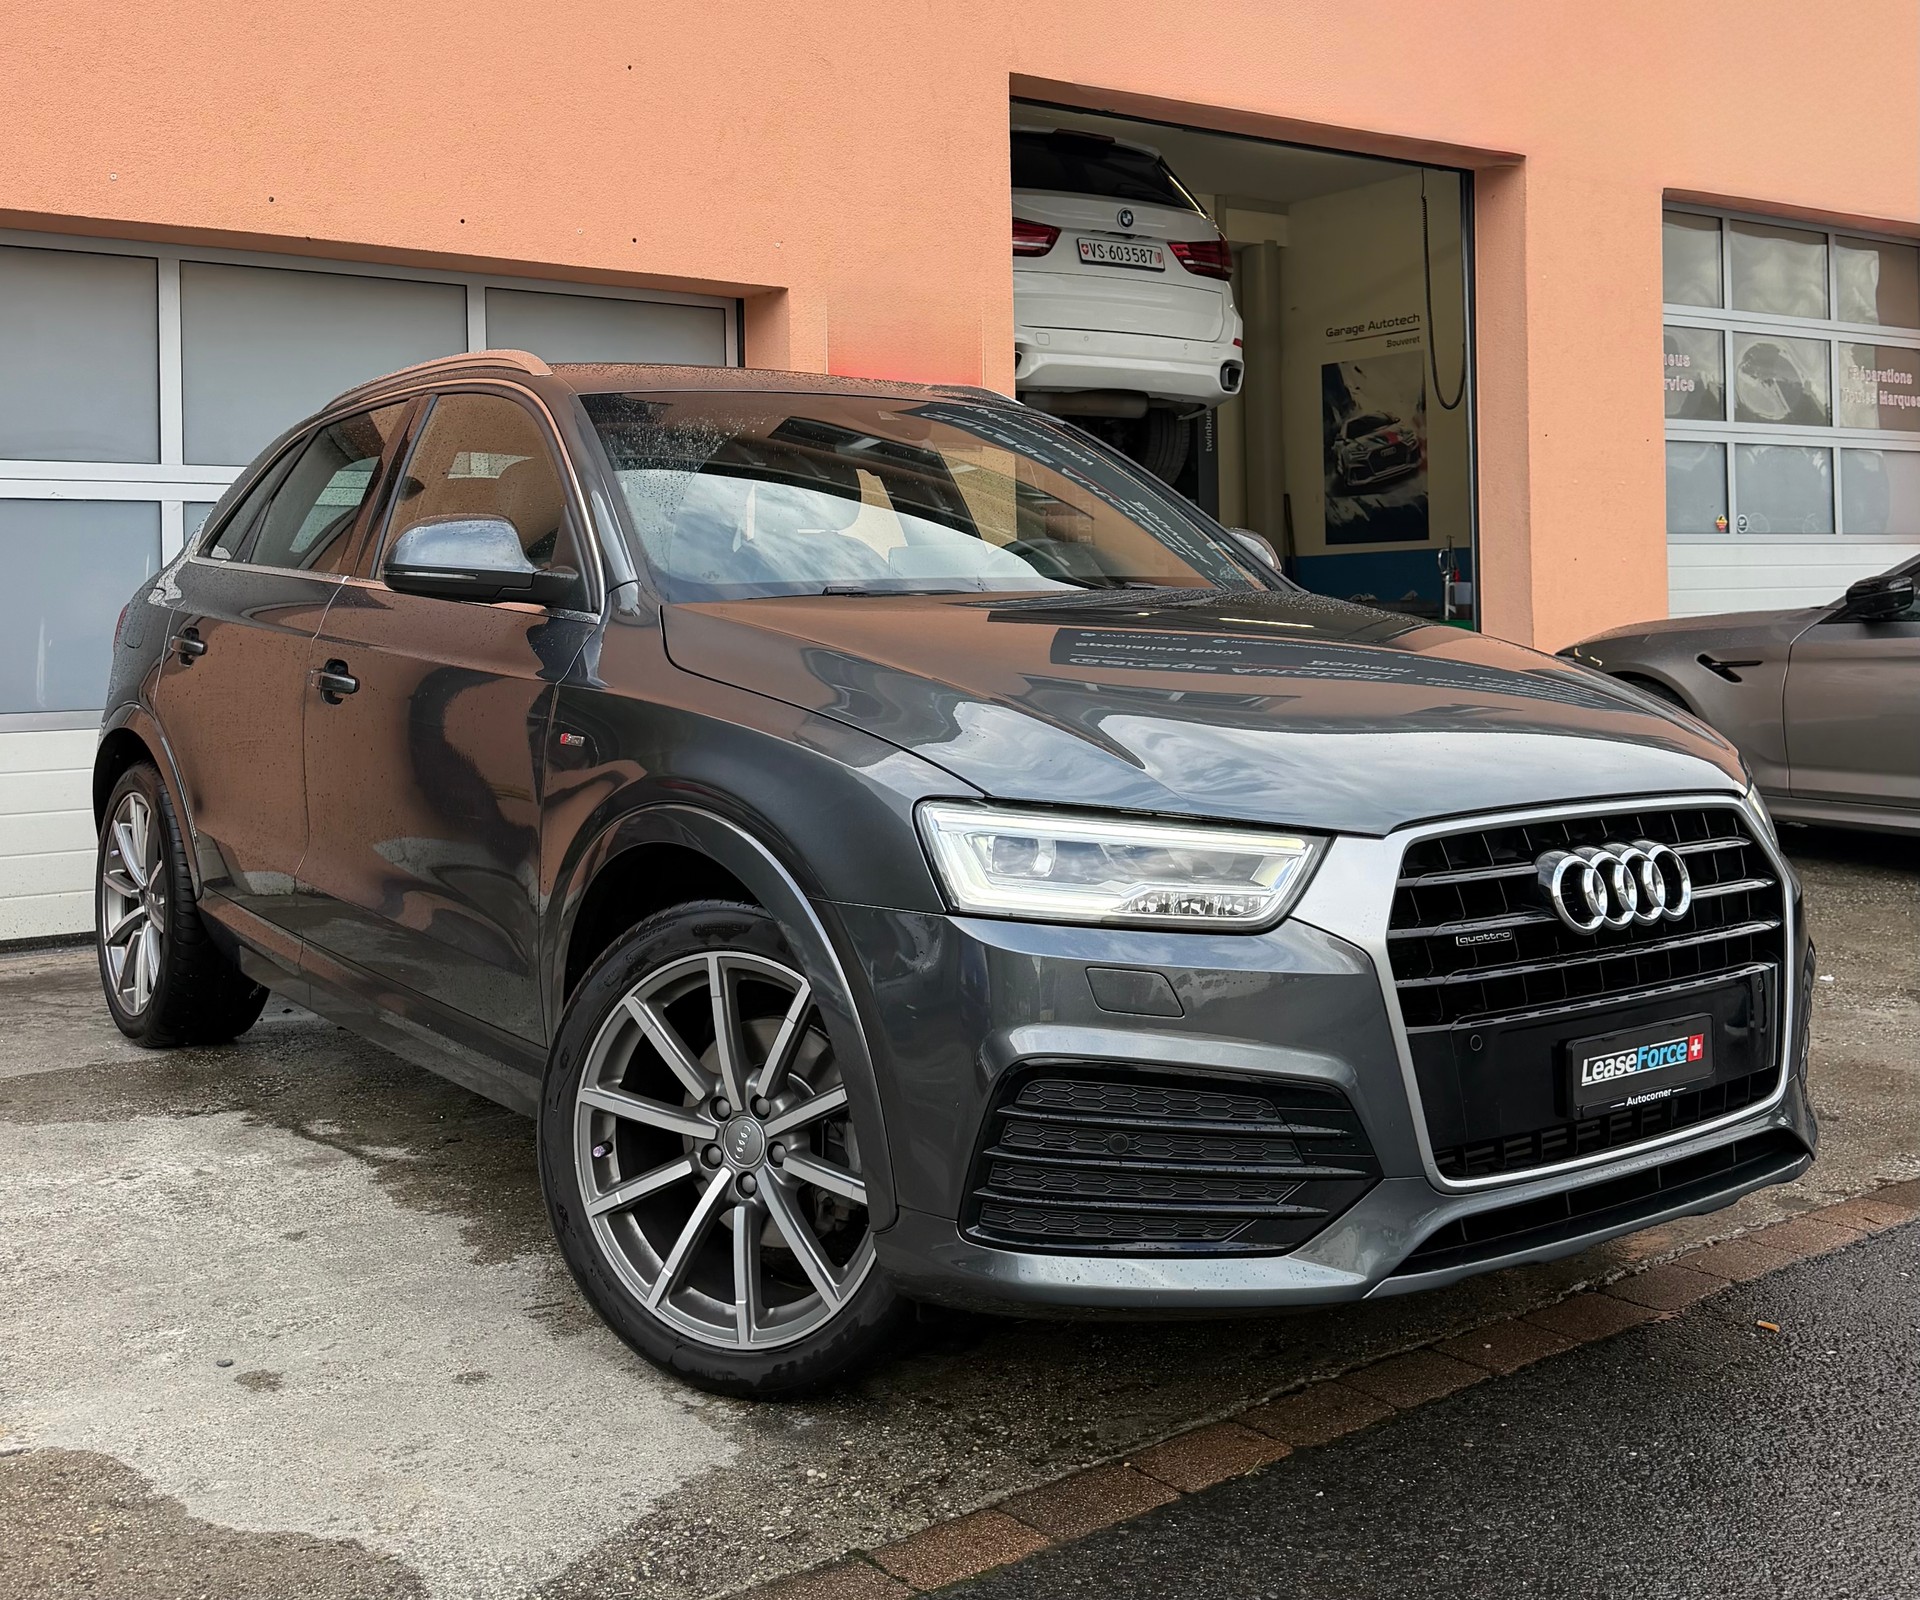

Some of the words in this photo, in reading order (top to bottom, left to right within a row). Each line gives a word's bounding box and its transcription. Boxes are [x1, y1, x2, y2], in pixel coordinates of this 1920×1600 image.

[1325, 324, 1365, 337] Garage
[1367, 313, 1421, 331] Autotech
[1386, 336, 1421, 348] Bouveret
[1848, 364, 1913, 385] Réparations
[638, 920, 679, 942] OUTSIDE
[1459, 931, 1511, 944] quattro
[1581, 1042, 1688, 1083] LeaseForce
[1626, 1088, 1672, 1107] Autocorner
